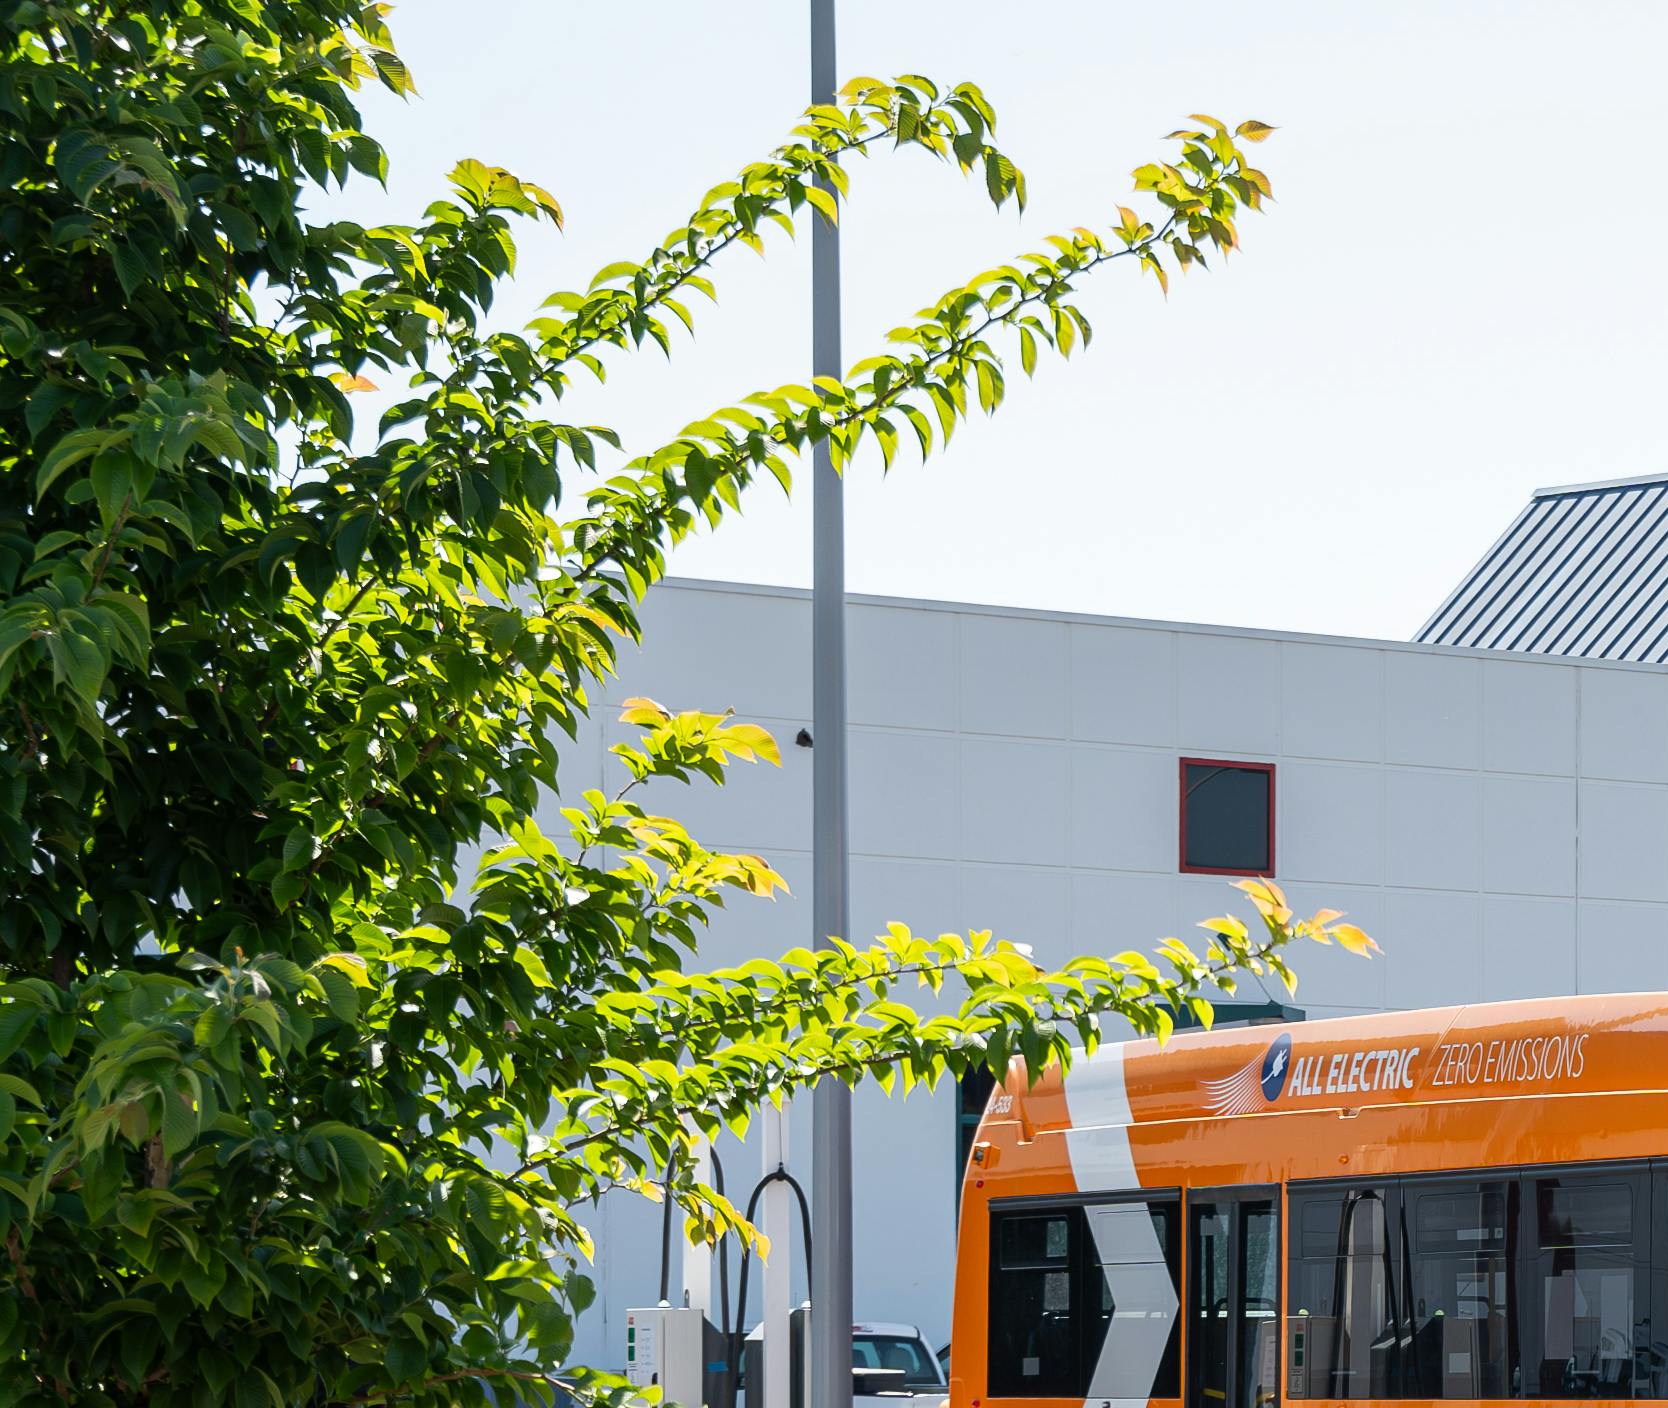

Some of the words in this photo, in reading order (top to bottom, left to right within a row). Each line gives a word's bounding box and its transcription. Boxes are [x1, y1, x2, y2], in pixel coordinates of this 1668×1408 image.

[1288, 1055, 1325, 1097] ALL
[1325, 1047, 1420, 1094] ELECTRIC
[1432, 1042, 1484, 1086] ZERO
[1484, 1033, 1589, 1083] EMISSIONS
